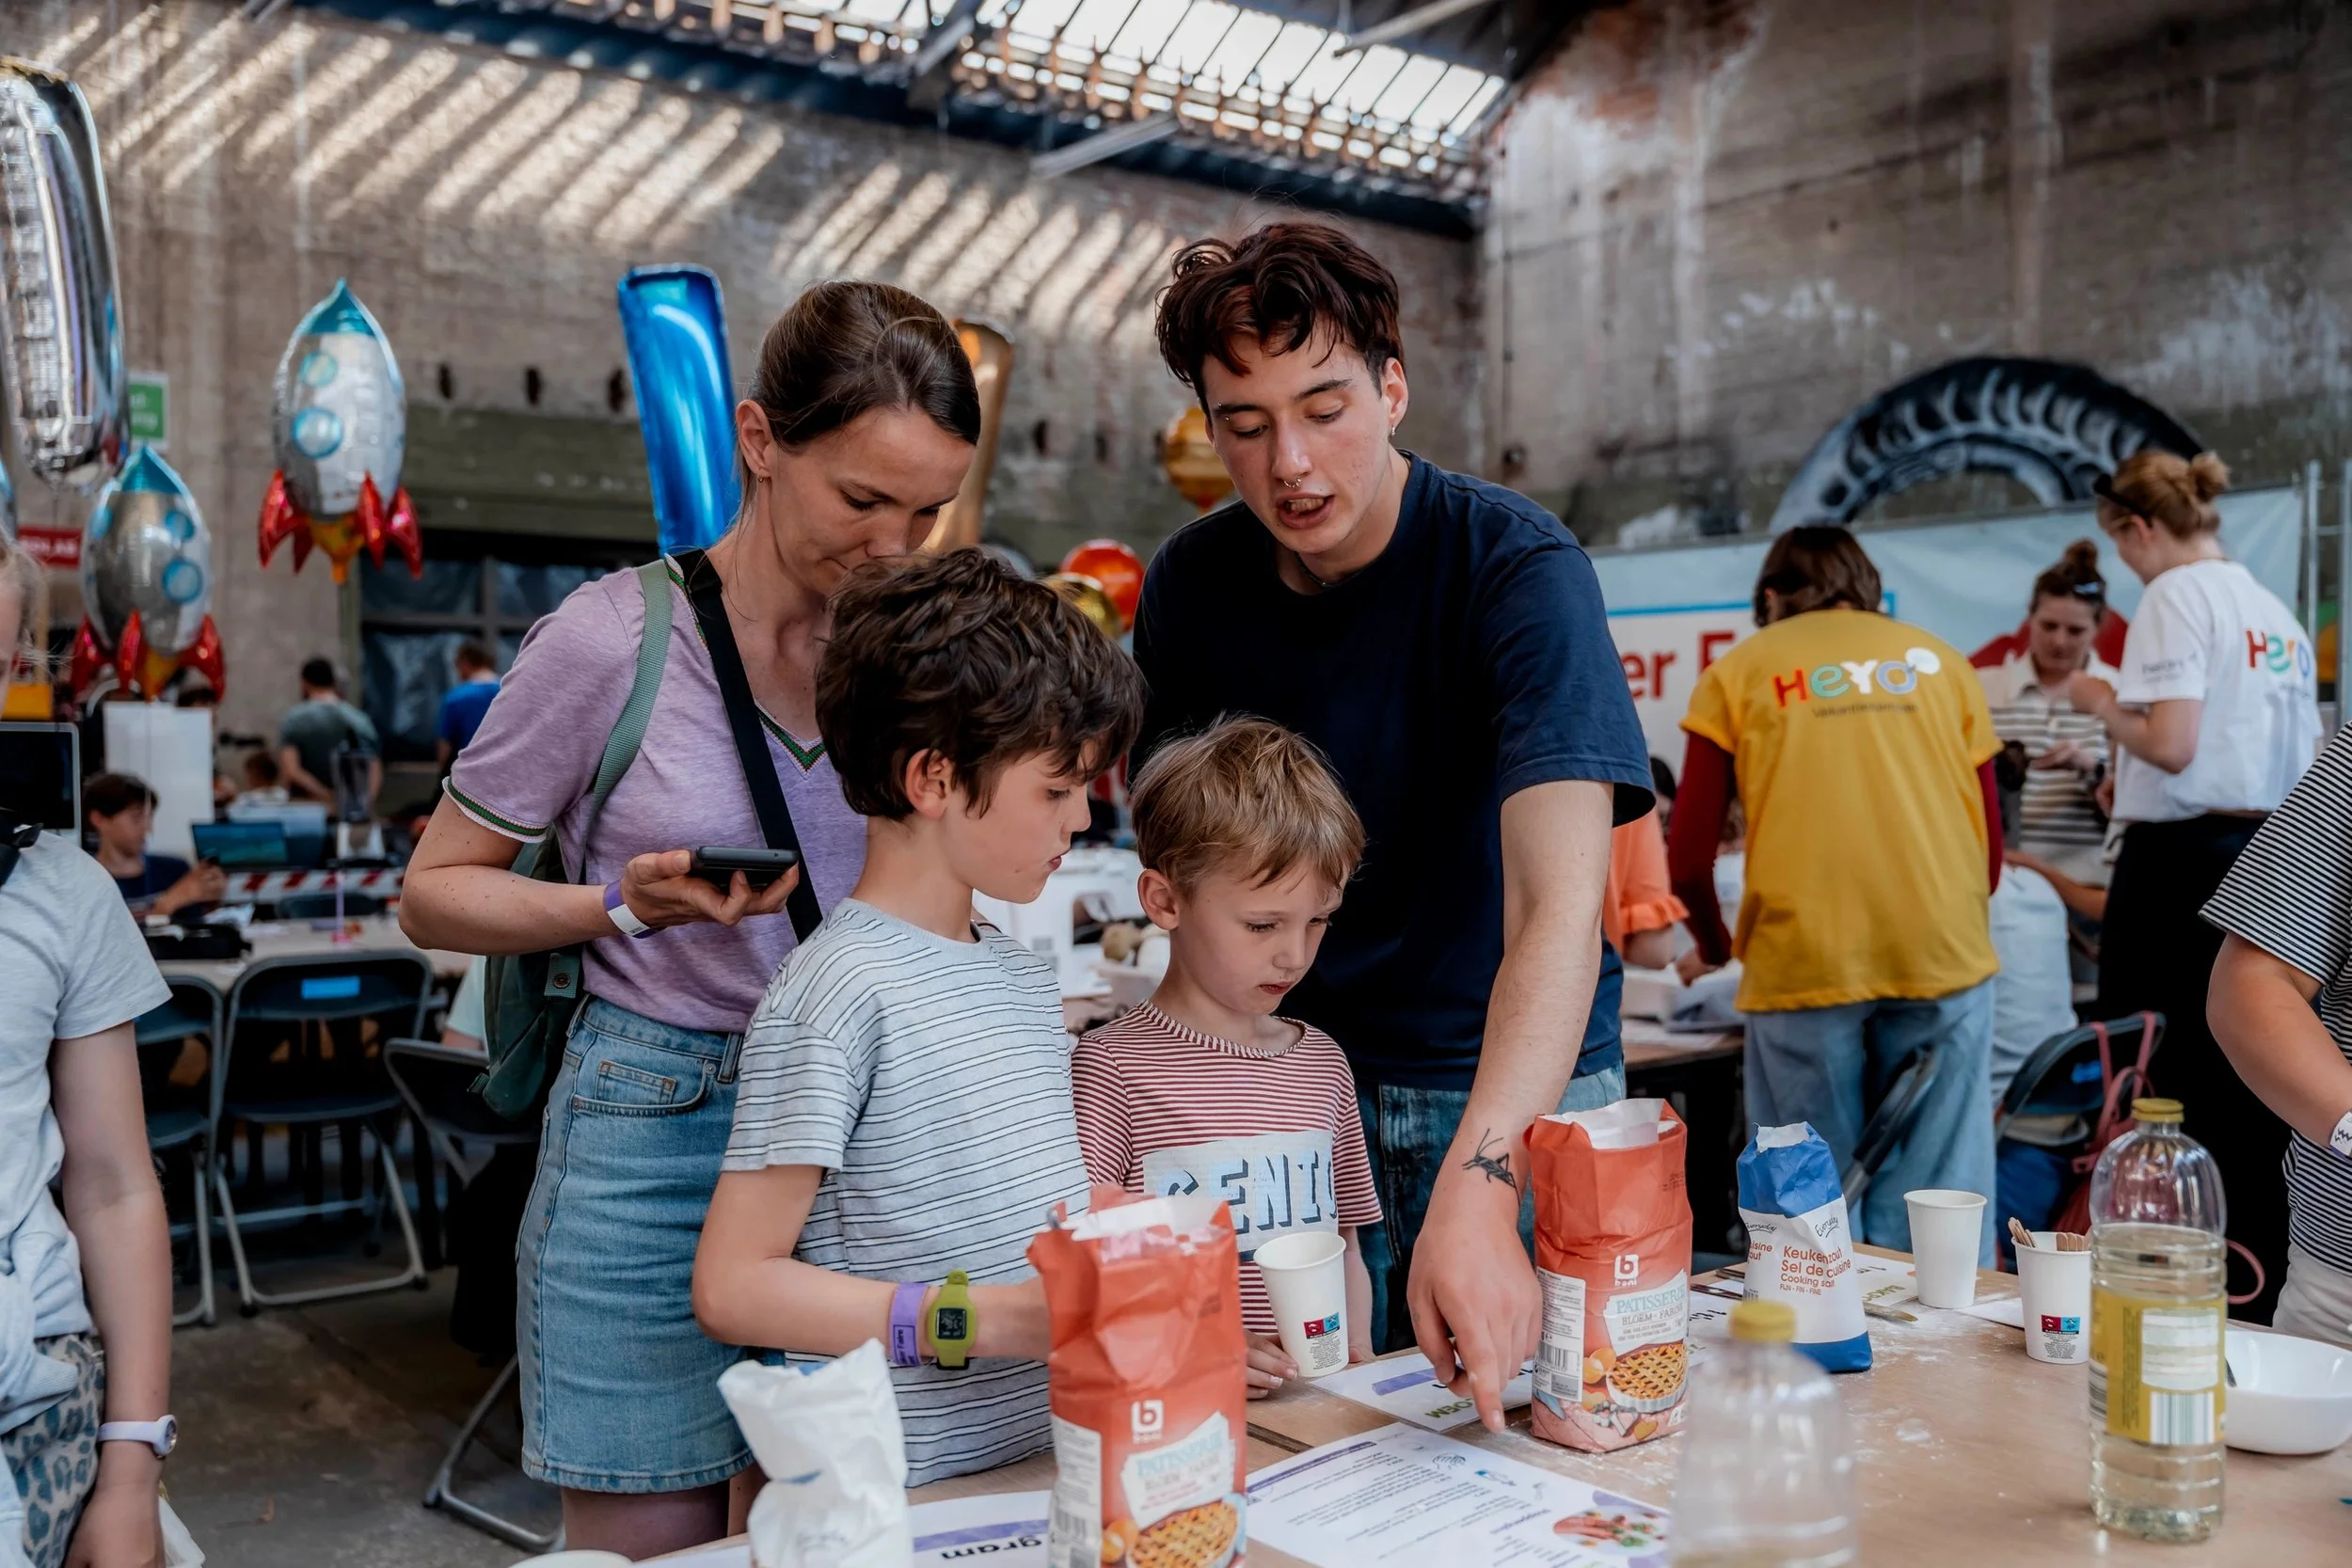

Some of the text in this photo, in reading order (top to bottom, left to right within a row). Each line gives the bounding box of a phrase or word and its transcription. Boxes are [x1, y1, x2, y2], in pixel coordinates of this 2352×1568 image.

[1814, 1213, 1839, 1238] Everyday
[1748, 1251, 1762, 1261] out
[1750, 1242, 1773, 1253] isine
[1783, 1246, 1843, 1265] Keukenzout
[1781, 1259, 1803, 1274] Sel
[1805, 1263, 1824, 1276] de
[1826, 1259, 1851, 1278] cuisine
[1780, 1273, 1836, 1289] Cooking salt
[1616, 1284, 1686, 1315] PATISSERIE
[1621, 1312, 1653, 1326] BLOEM
[1423, 1398, 1474, 1419] OEM
[942, 1534, 1042, 1560] gram
